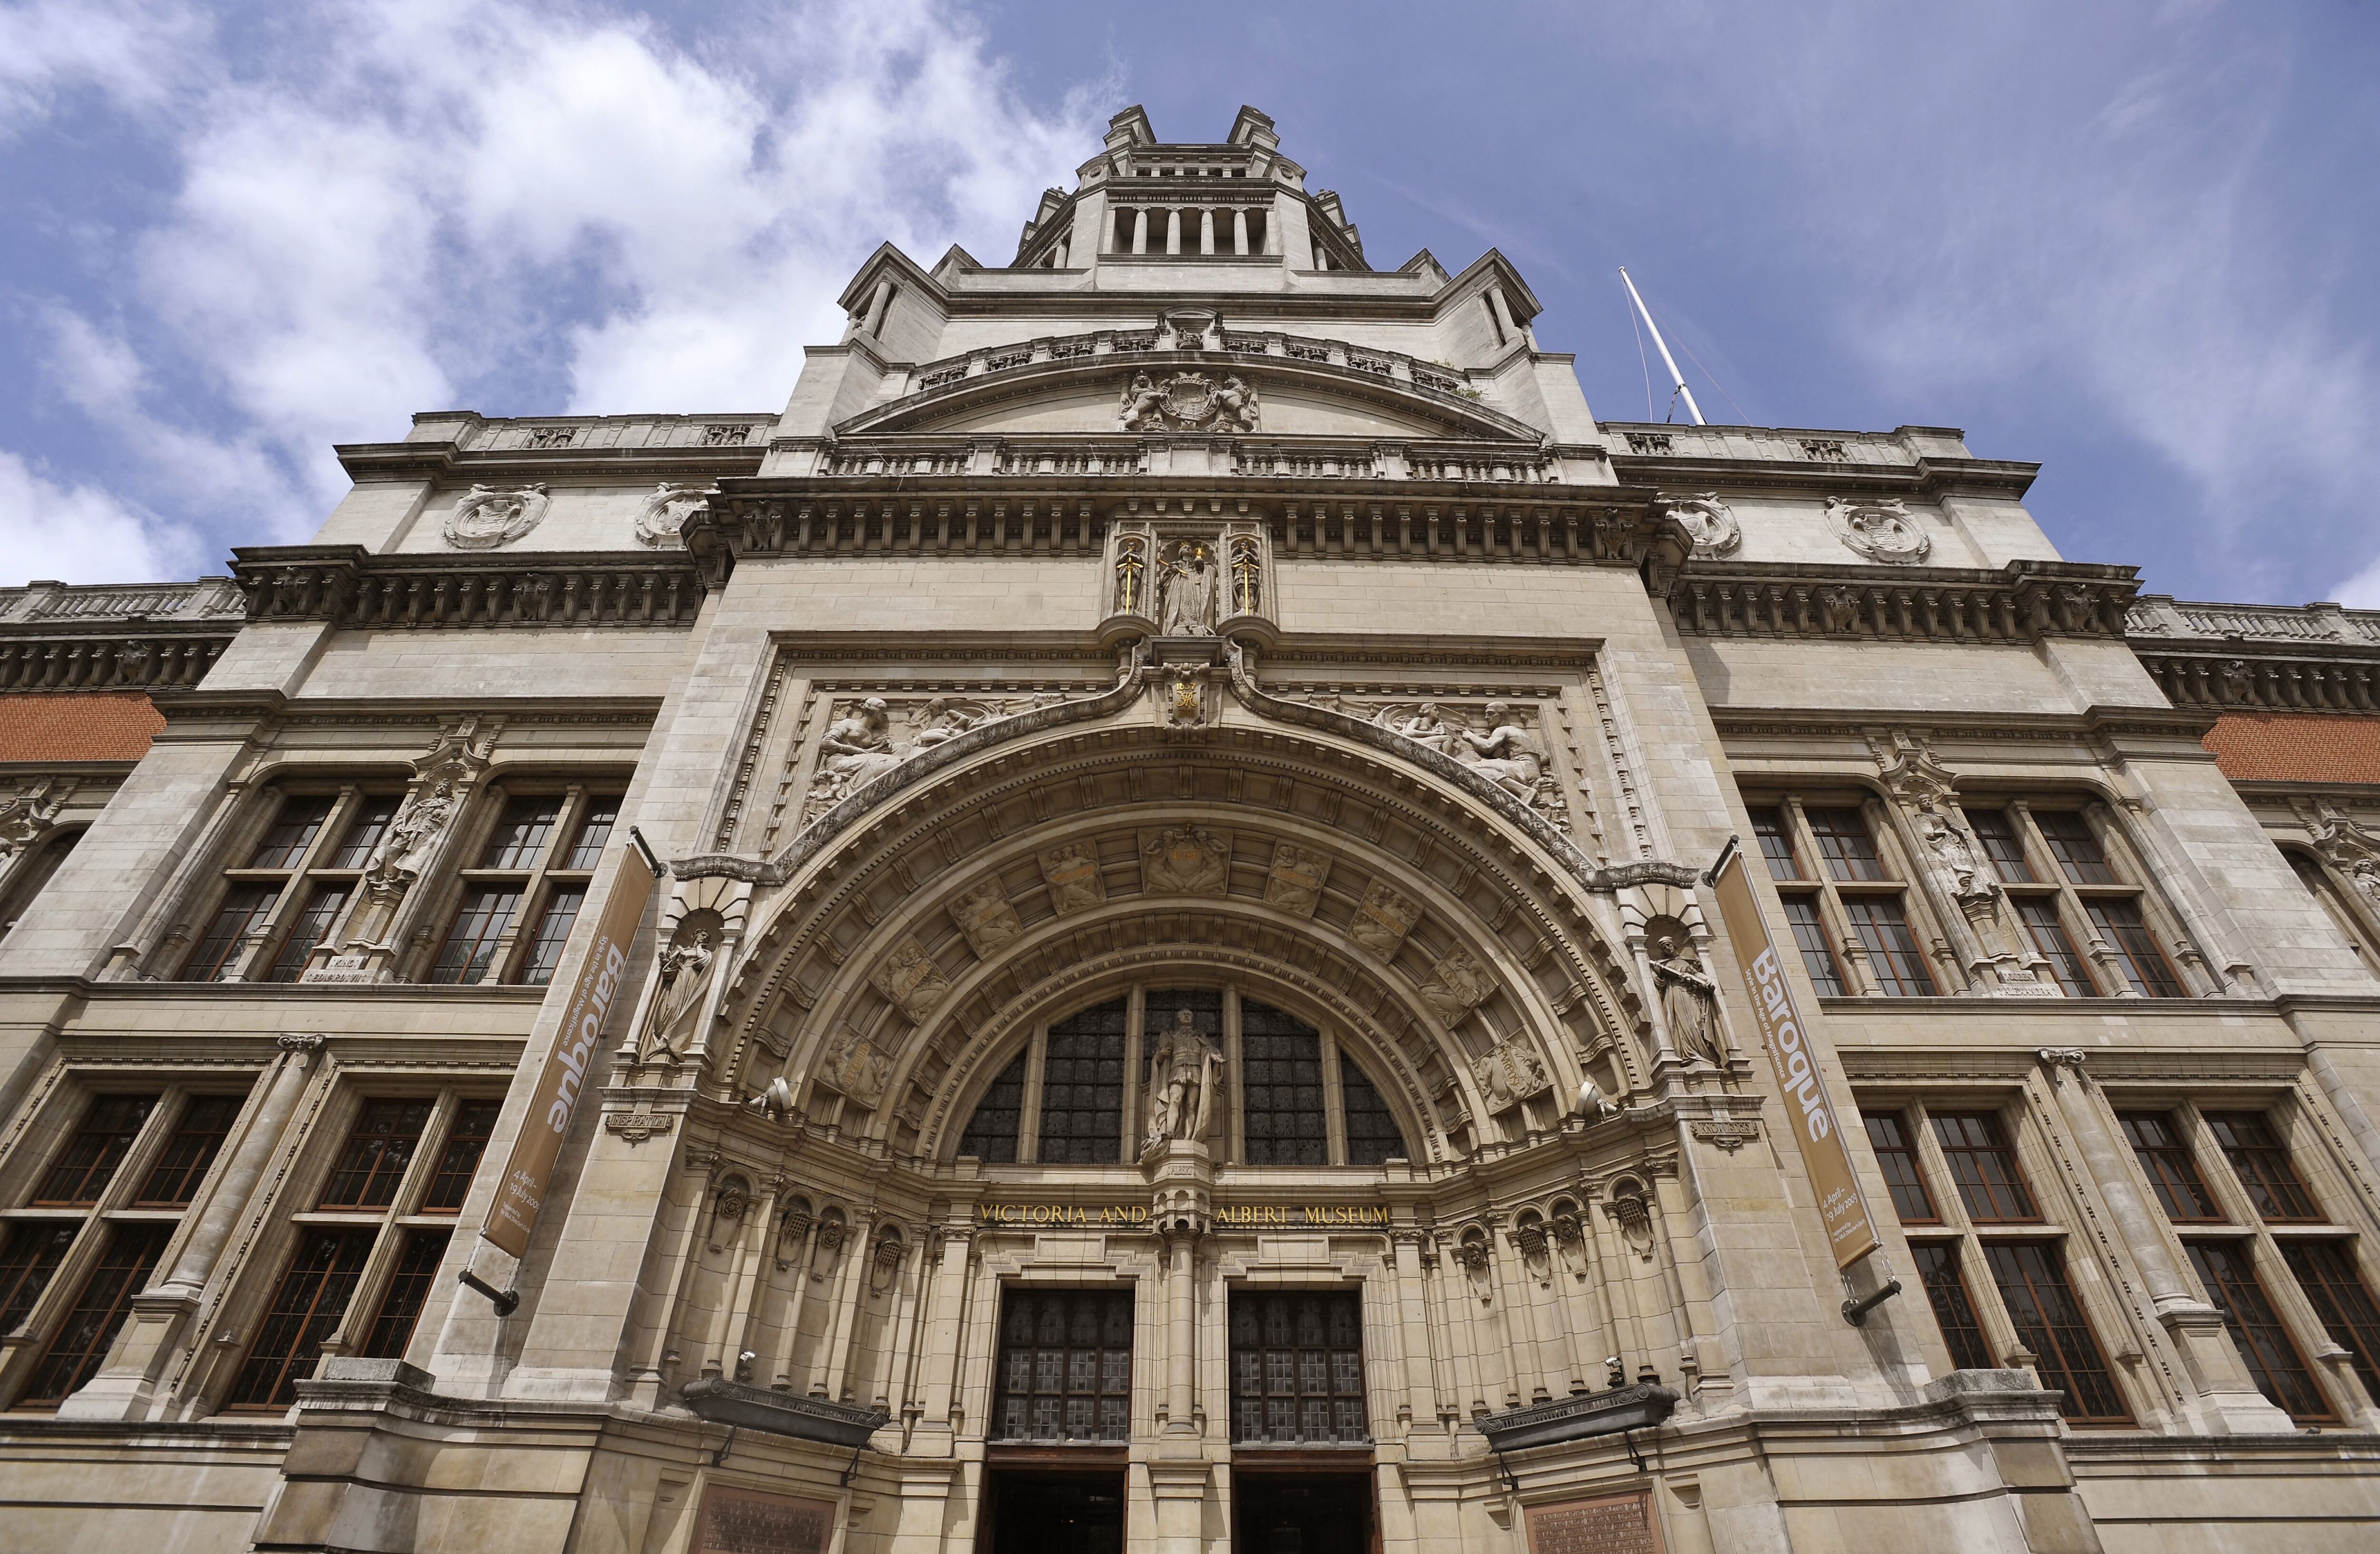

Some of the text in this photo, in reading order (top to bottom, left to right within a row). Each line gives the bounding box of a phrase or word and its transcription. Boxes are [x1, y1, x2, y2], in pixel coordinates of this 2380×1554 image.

[598, 935, 608, 952] Style
[595, 953, 602, 961] in
[585, 973, 594, 988] Age
[1444, 972, 1468, 999] OF ITS
[1745, 969, 1754, 987] Style
[581, 989, 588, 999] of
[1751, 986, 1756, 995] in
[563, 998, 586, 1046] Magnificence
[1758, 1007, 1766, 1022] Age
[1764, 1022, 1771, 1031] of
[547, 943, 625, 1133] Baroque
[1752, 945, 1828, 1143] Baroque
[1766, 1030, 1786, 1079] Magnificence
[611, 1115, 666, 1127] INSPIRATION
[1699, 1123, 1751, 1134] KNOWLEDGE
[514, 1170, 520, 1180] 4
[510, 1183, 517, 1195] 19
[516, 1186, 528, 1203] July
[1824, 1199, 1828, 1209] 4
[1834, 1202, 1845, 1215] July
[1844, 1193, 1858, 1209] 2009
[980, 1204, 1389, 1224] VICTORIA AND ALBERT MUSEUM
